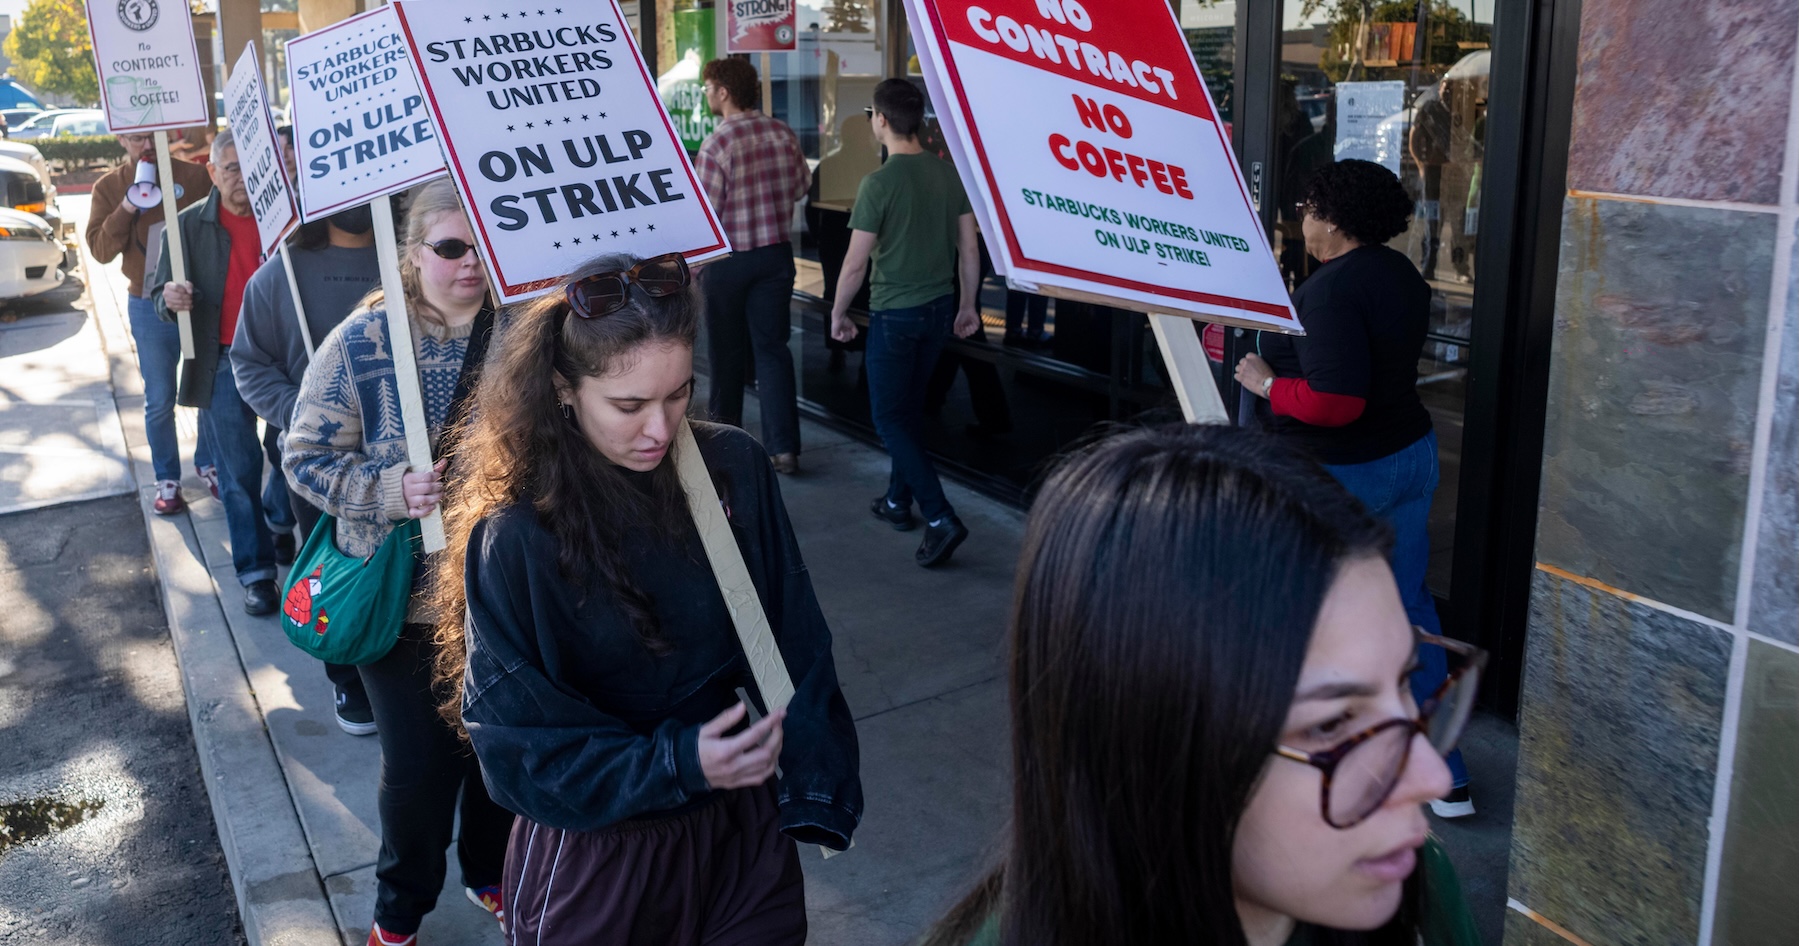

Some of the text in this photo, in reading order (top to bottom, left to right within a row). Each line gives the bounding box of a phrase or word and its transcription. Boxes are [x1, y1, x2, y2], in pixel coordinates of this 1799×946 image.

[736, 0, 788, 17] STRONG!
[1035, 0, 1092, 32] NO
[112, 54, 184, 73] CONTRACT.
[297, 33, 402, 80] STARBUCK
[426, 23, 617, 63] STARBUCKS
[966, 6, 1178, 100] CONTRACT
[309, 46, 407, 91] WORKERS
[325, 67, 398, 102] UNITED
[451, 49, 613, 87] WORKERS
[129, 91, 180, 107] COFFEE!
[229, 73, 258, 128] STARBUCKS
[235, 94, 259, 140] WORKERS
[486, 78, 601, 110] UNITED
[1071, 93, 1132, 139] NO
[242, 117, 259, 151] UNITED
[309, 94, 422, 149] ON ULP
[247, 146, 272, 195] ON ULP
[309, 118, 434, 179] STRIKE
[478, 129, 653, 183] ON ULP
[1048, 133, 1194, 200] COFFEE
[254, 169, 283, 222] STRIKE
[490, 167, 685, 231] STRIKE
[1021, 188, 1250, 253] STARBUCKS WORKERS UNITED
[1095, 229, 1212, 268] ON ULP STRIKE!
